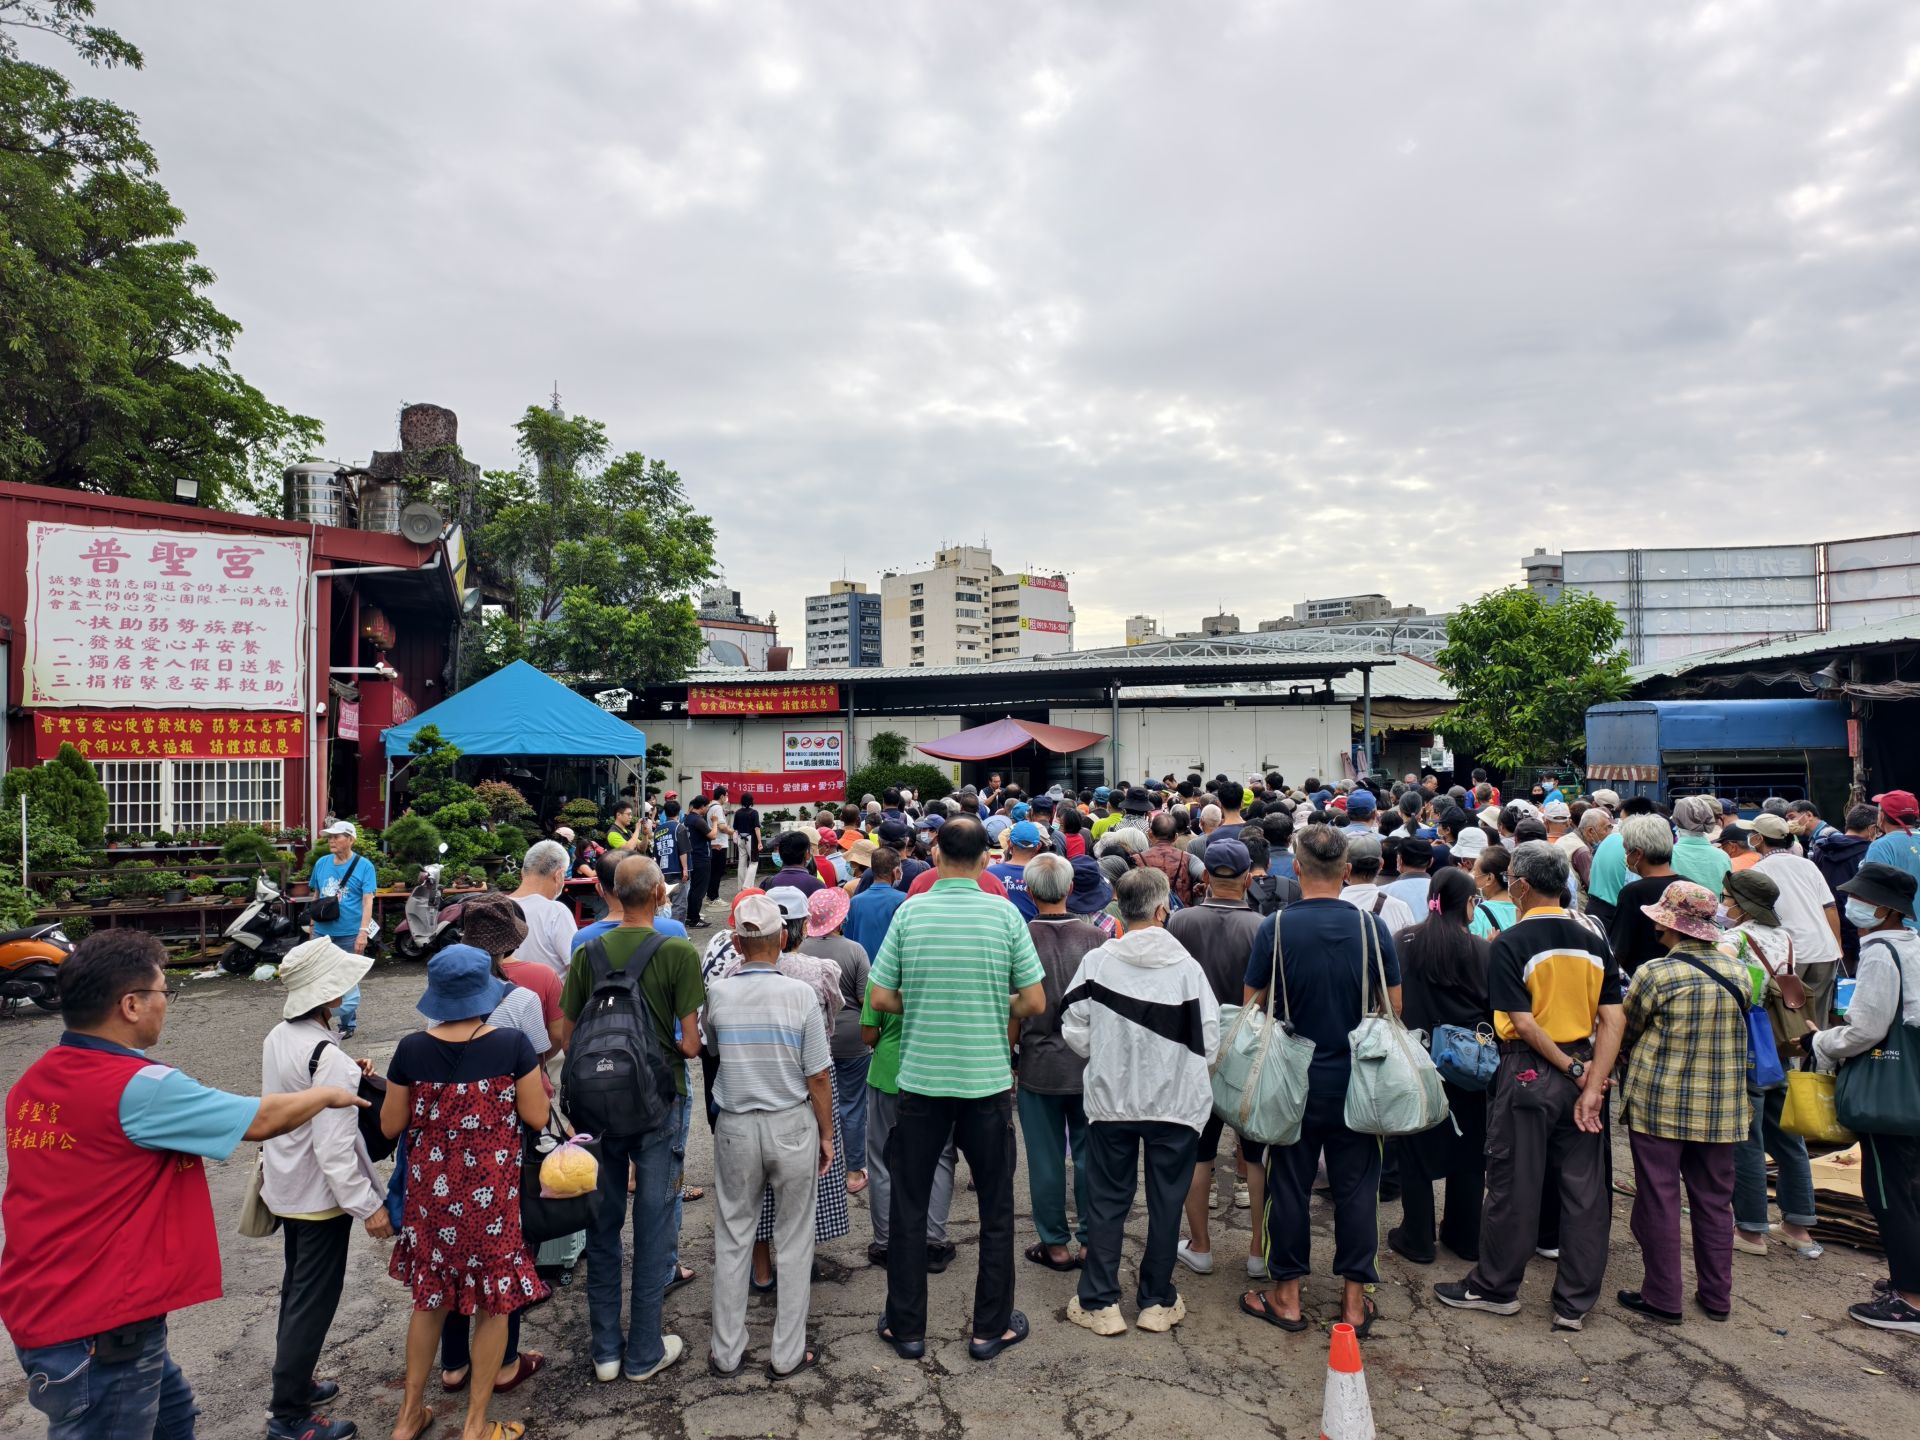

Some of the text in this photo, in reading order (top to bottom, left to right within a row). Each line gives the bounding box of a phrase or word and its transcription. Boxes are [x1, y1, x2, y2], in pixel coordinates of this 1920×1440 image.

[79, 537, 265, 579] 普聖宮
[41, 717, 204, 734] 普聖宮愛心便當發放給
[209, 738, 289, 754] 請體諒感恩
[17, 1099, 60, 1124] 普聖宮
